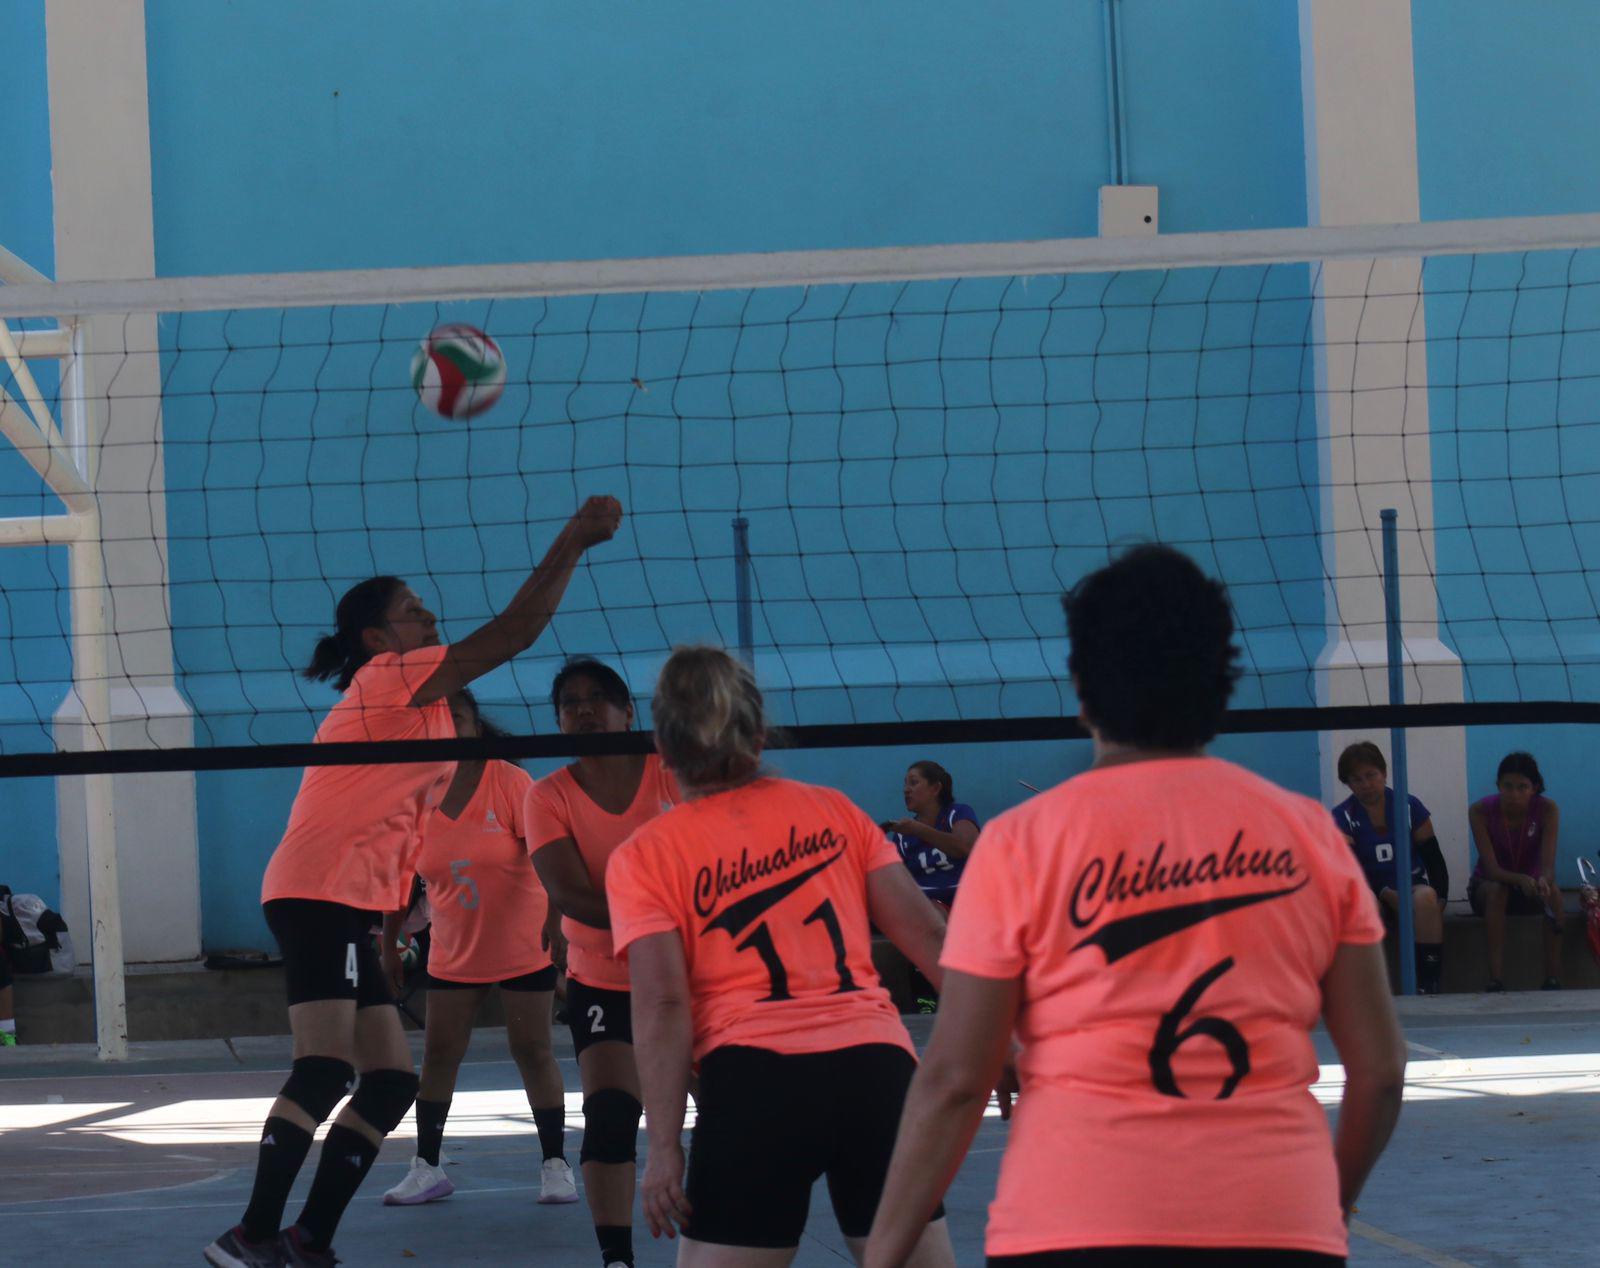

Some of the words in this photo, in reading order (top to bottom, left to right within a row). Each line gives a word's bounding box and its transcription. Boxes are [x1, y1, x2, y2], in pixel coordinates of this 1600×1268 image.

[450, 859, 480, 910] 5
[694, 825, 837, 918] Chihuahua
[1069, 829, 1297, 928] Chihuahua
[345, 943, 358, 987] 4
[736, 898, 866, 1003] 11
[587, 1005, 606, 1033] 2
[1148, 956, 1250, 1100] 6
